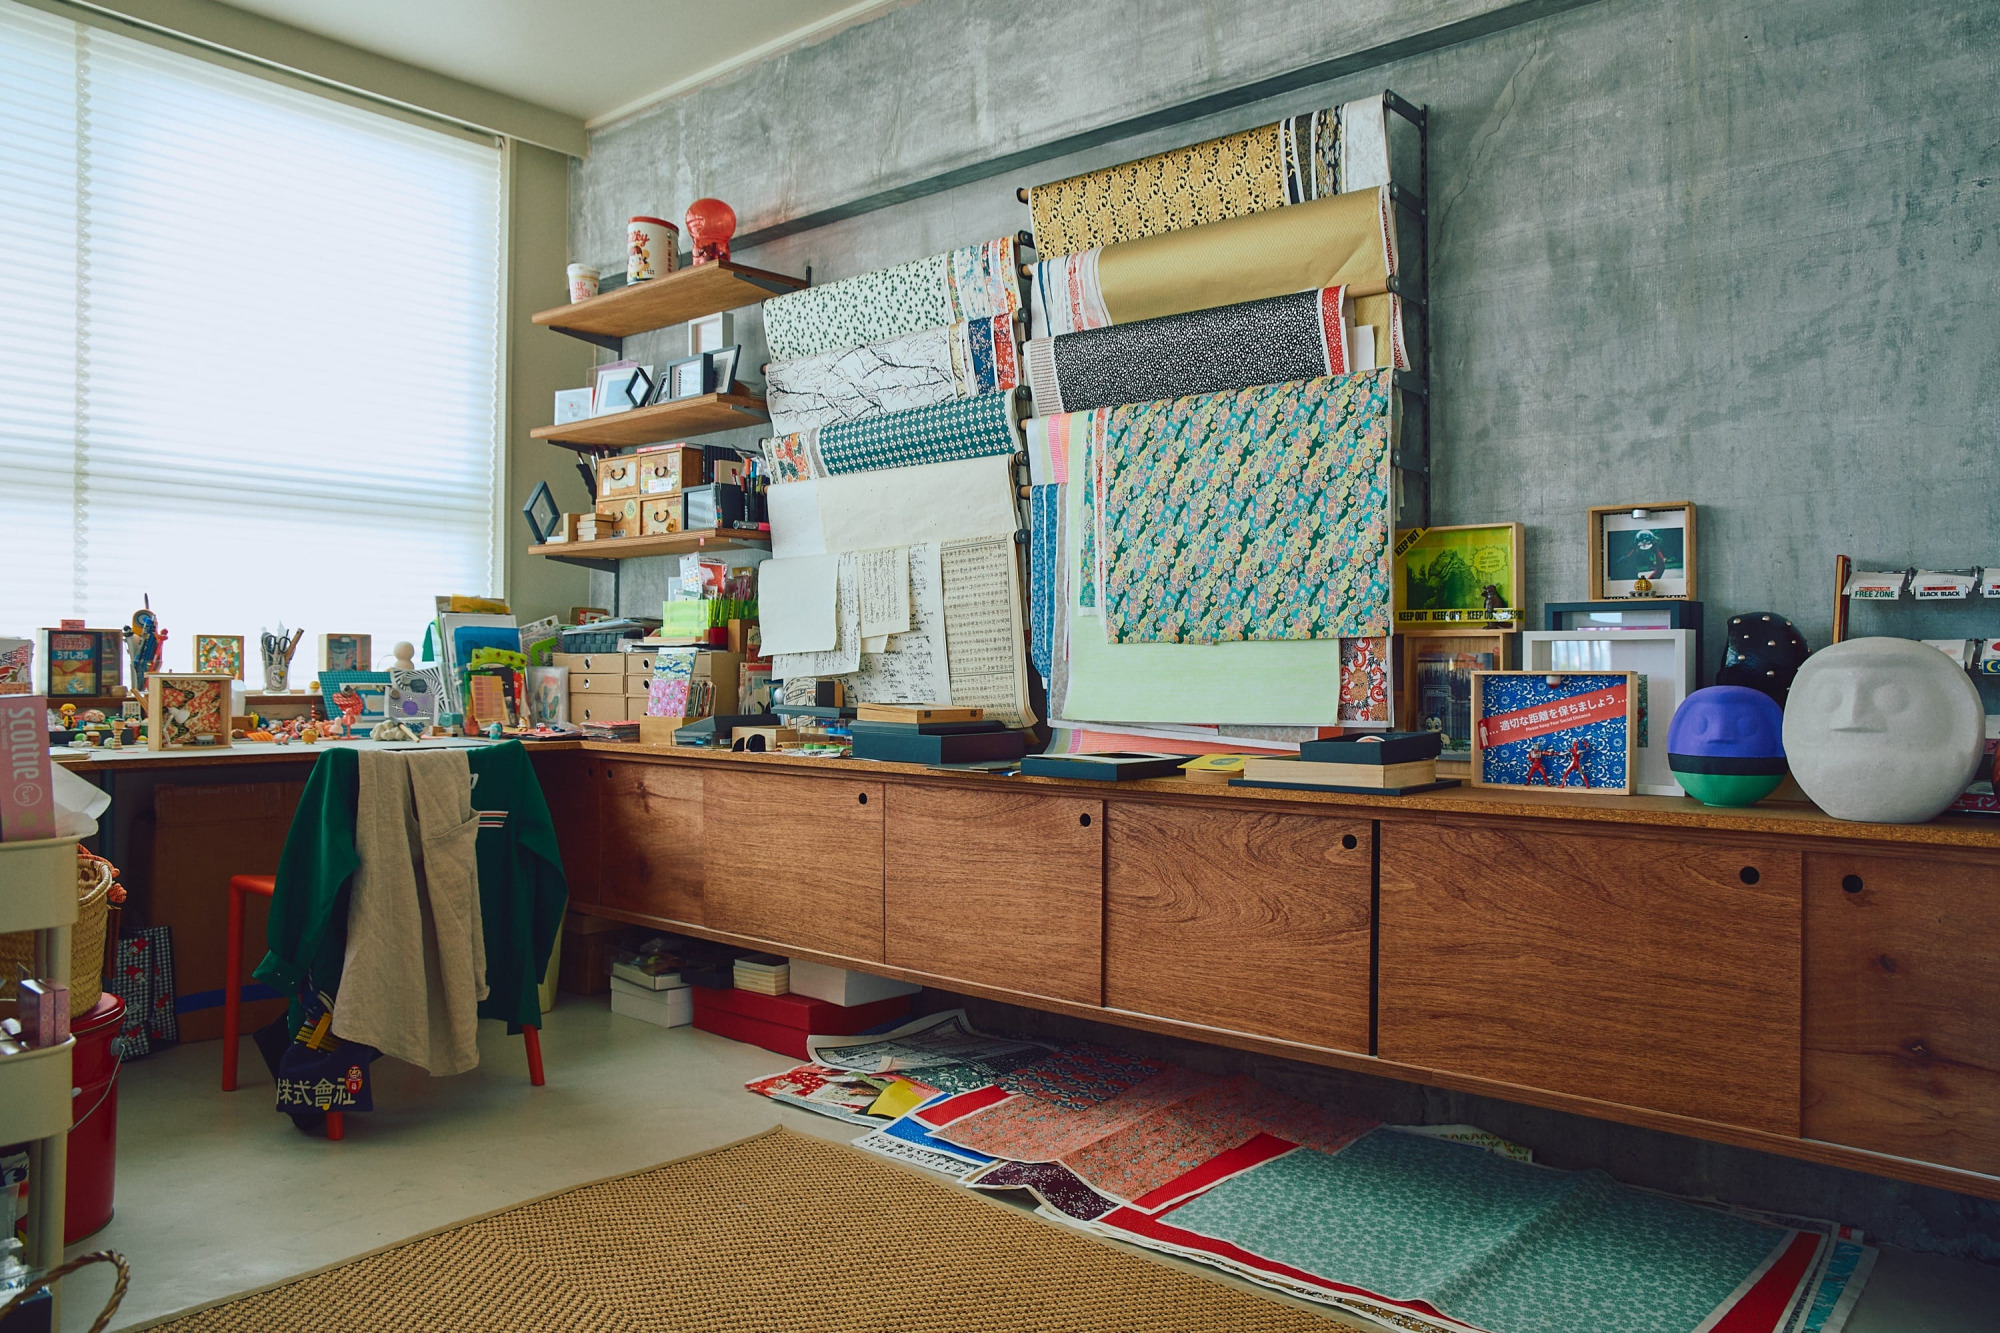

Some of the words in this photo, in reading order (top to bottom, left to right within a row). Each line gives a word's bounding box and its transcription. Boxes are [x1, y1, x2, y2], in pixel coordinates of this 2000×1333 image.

[1394, 540, 1409, 557] KEEP
[1407, 529, 1420, 545] OUT
[1875, 590, 1895, 598] ZONE
[1398, 611, 1415, 621] KEEP
[1415, 611, 1428, 621] OUT
[1432, 611, 1447, 621] KEEP
[1467, 611, 1483, 620] KEEP
[1572, 713, 1591, 721] Distance
